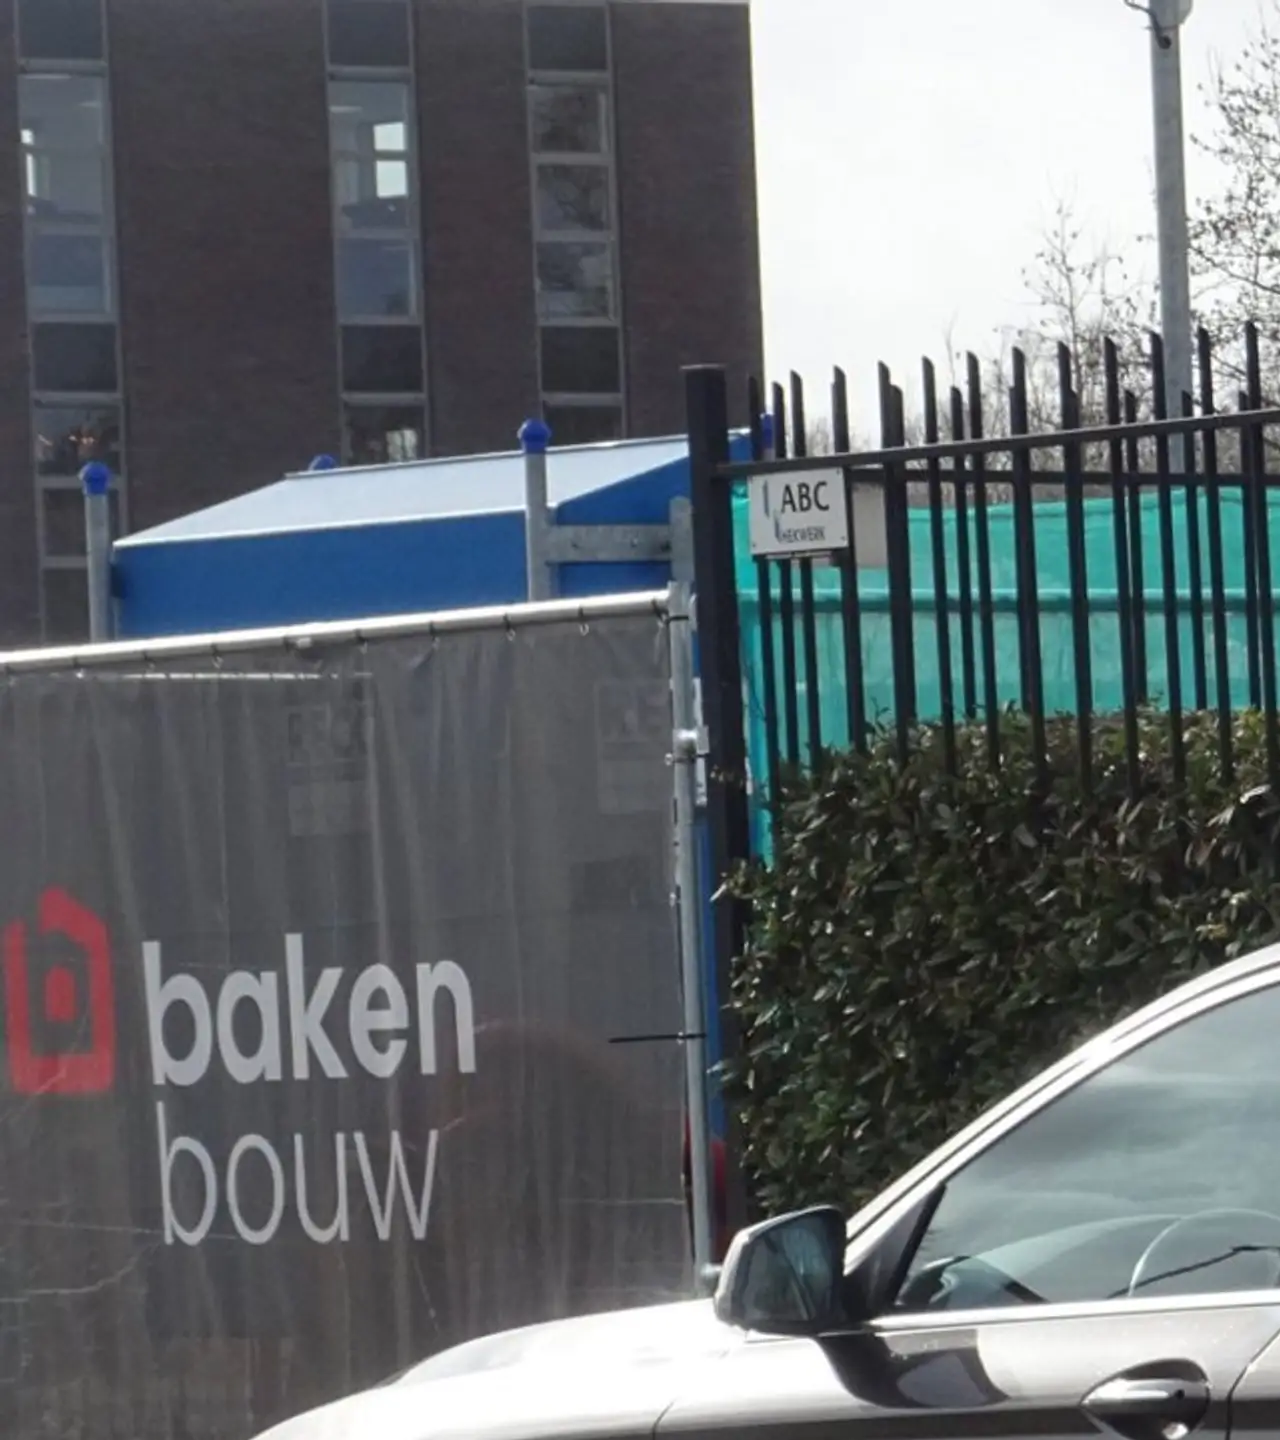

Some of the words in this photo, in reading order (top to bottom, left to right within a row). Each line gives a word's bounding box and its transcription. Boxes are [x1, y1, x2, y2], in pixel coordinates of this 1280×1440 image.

[781, 481, 830, 513] ABC
[142, 933, 477, 1085] baken
[156, 1102, 438, 1246] bouw
